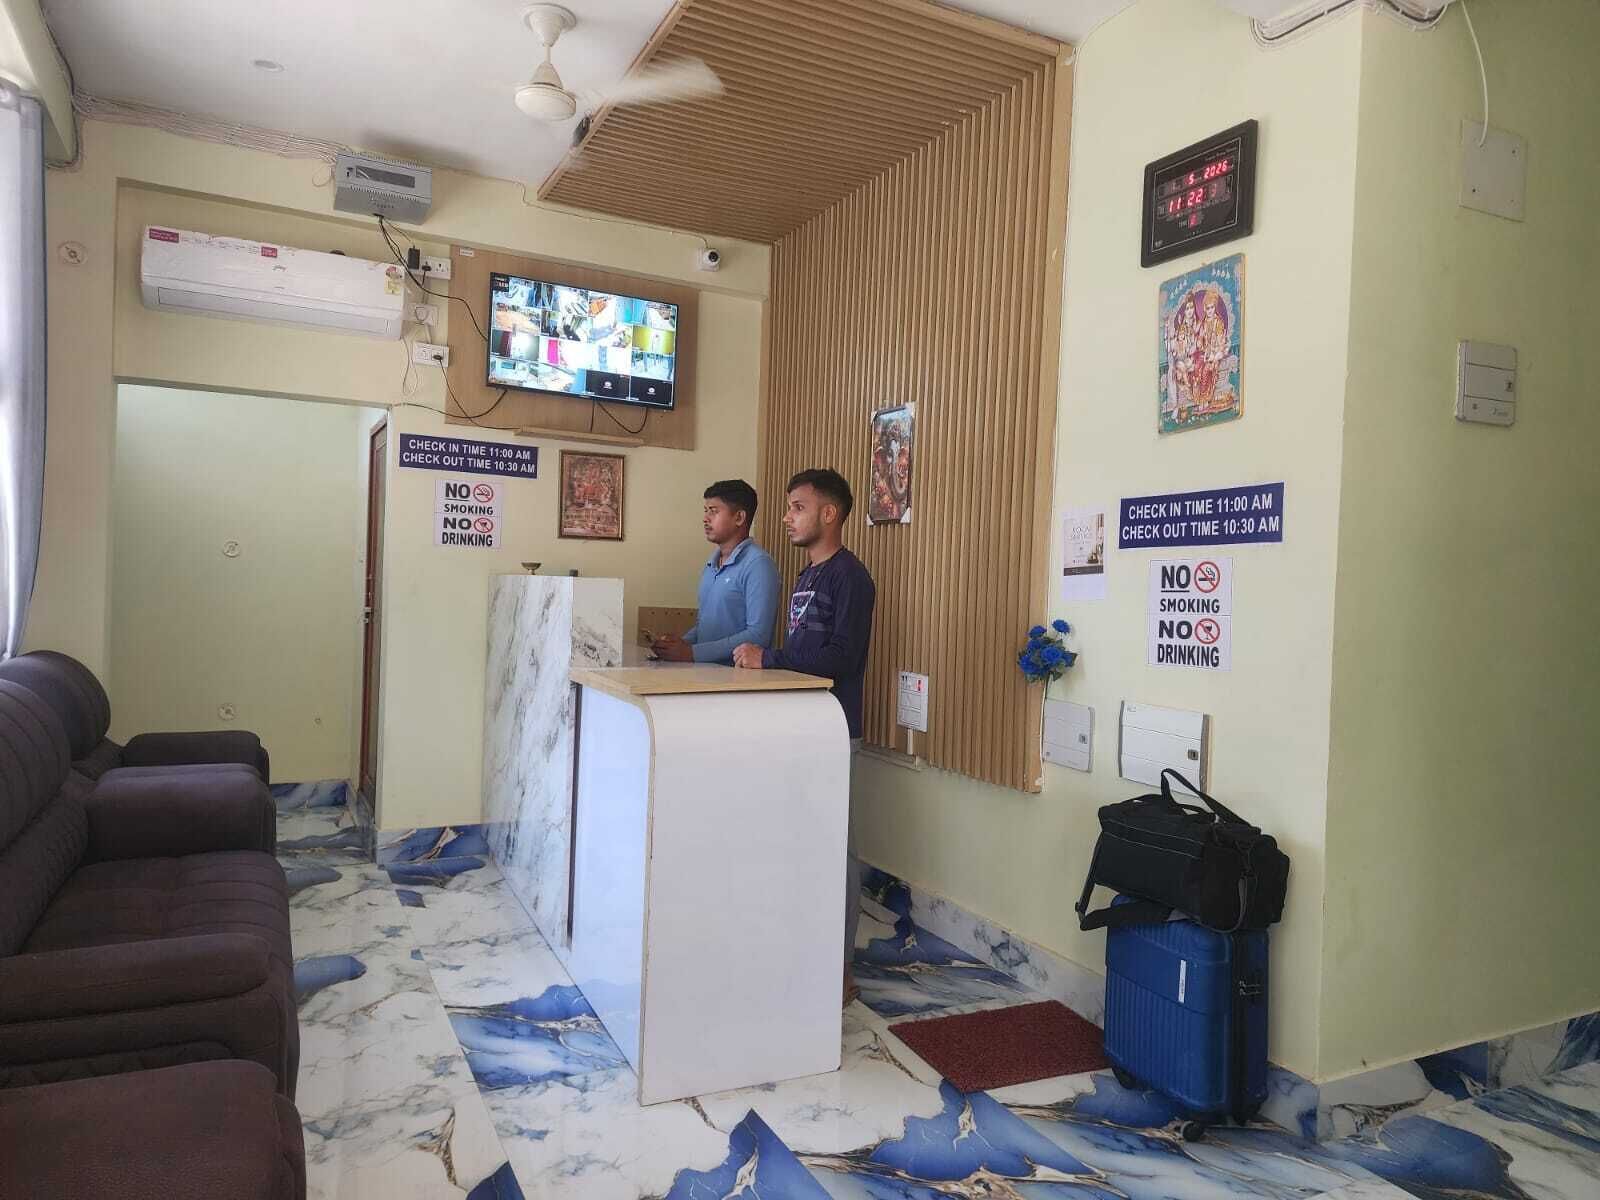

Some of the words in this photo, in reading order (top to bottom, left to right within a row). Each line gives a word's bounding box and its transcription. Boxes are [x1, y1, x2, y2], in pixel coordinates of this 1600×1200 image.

[409, 439, 447, 452] CHECK
[448, 443, 459, 453] IN
[462, 444, 486, 456] TIME
[490, 447, 513, 458] 11:00
[515, 450, 531, 460] AM
[402, 452, 440, 465] CHECK
[442, 455, 465, 467] OUT
[467, 457, 491, 469] TIME
[494, 460, 518, 472] 10:30
[520, 463, 535, 473] AM
[445, 482, 471, 499] NO
[443, 503, 494, 516] SMOKING
[1128, 503, 1167, 520] CHECK
[1169, 501, 1181, 517] IN
[1184, 498, 1214, 516] TIME
[1216, 495, 1248, 513] 11:00
[1251, 492, 1273, 510] AM
[443, 516, 472, 530] NO
[1122, 524, 1160, 540] CHECK
[1163, 522, 1187, 538] OUT
[1190, 520, 1220, 537] TIME
[1223, 517, 1255, 535] 10:30
[1257, 515, 1280, 533] AM
[441, 531, 493, 547] DRINKING
[1161, 564, 1191, 589] NO
[1159, 598, 1221, 614] SMOKING
[1158, 620, 1193, 640] NO
[1157, 643, 1220, 668] DRINKING
